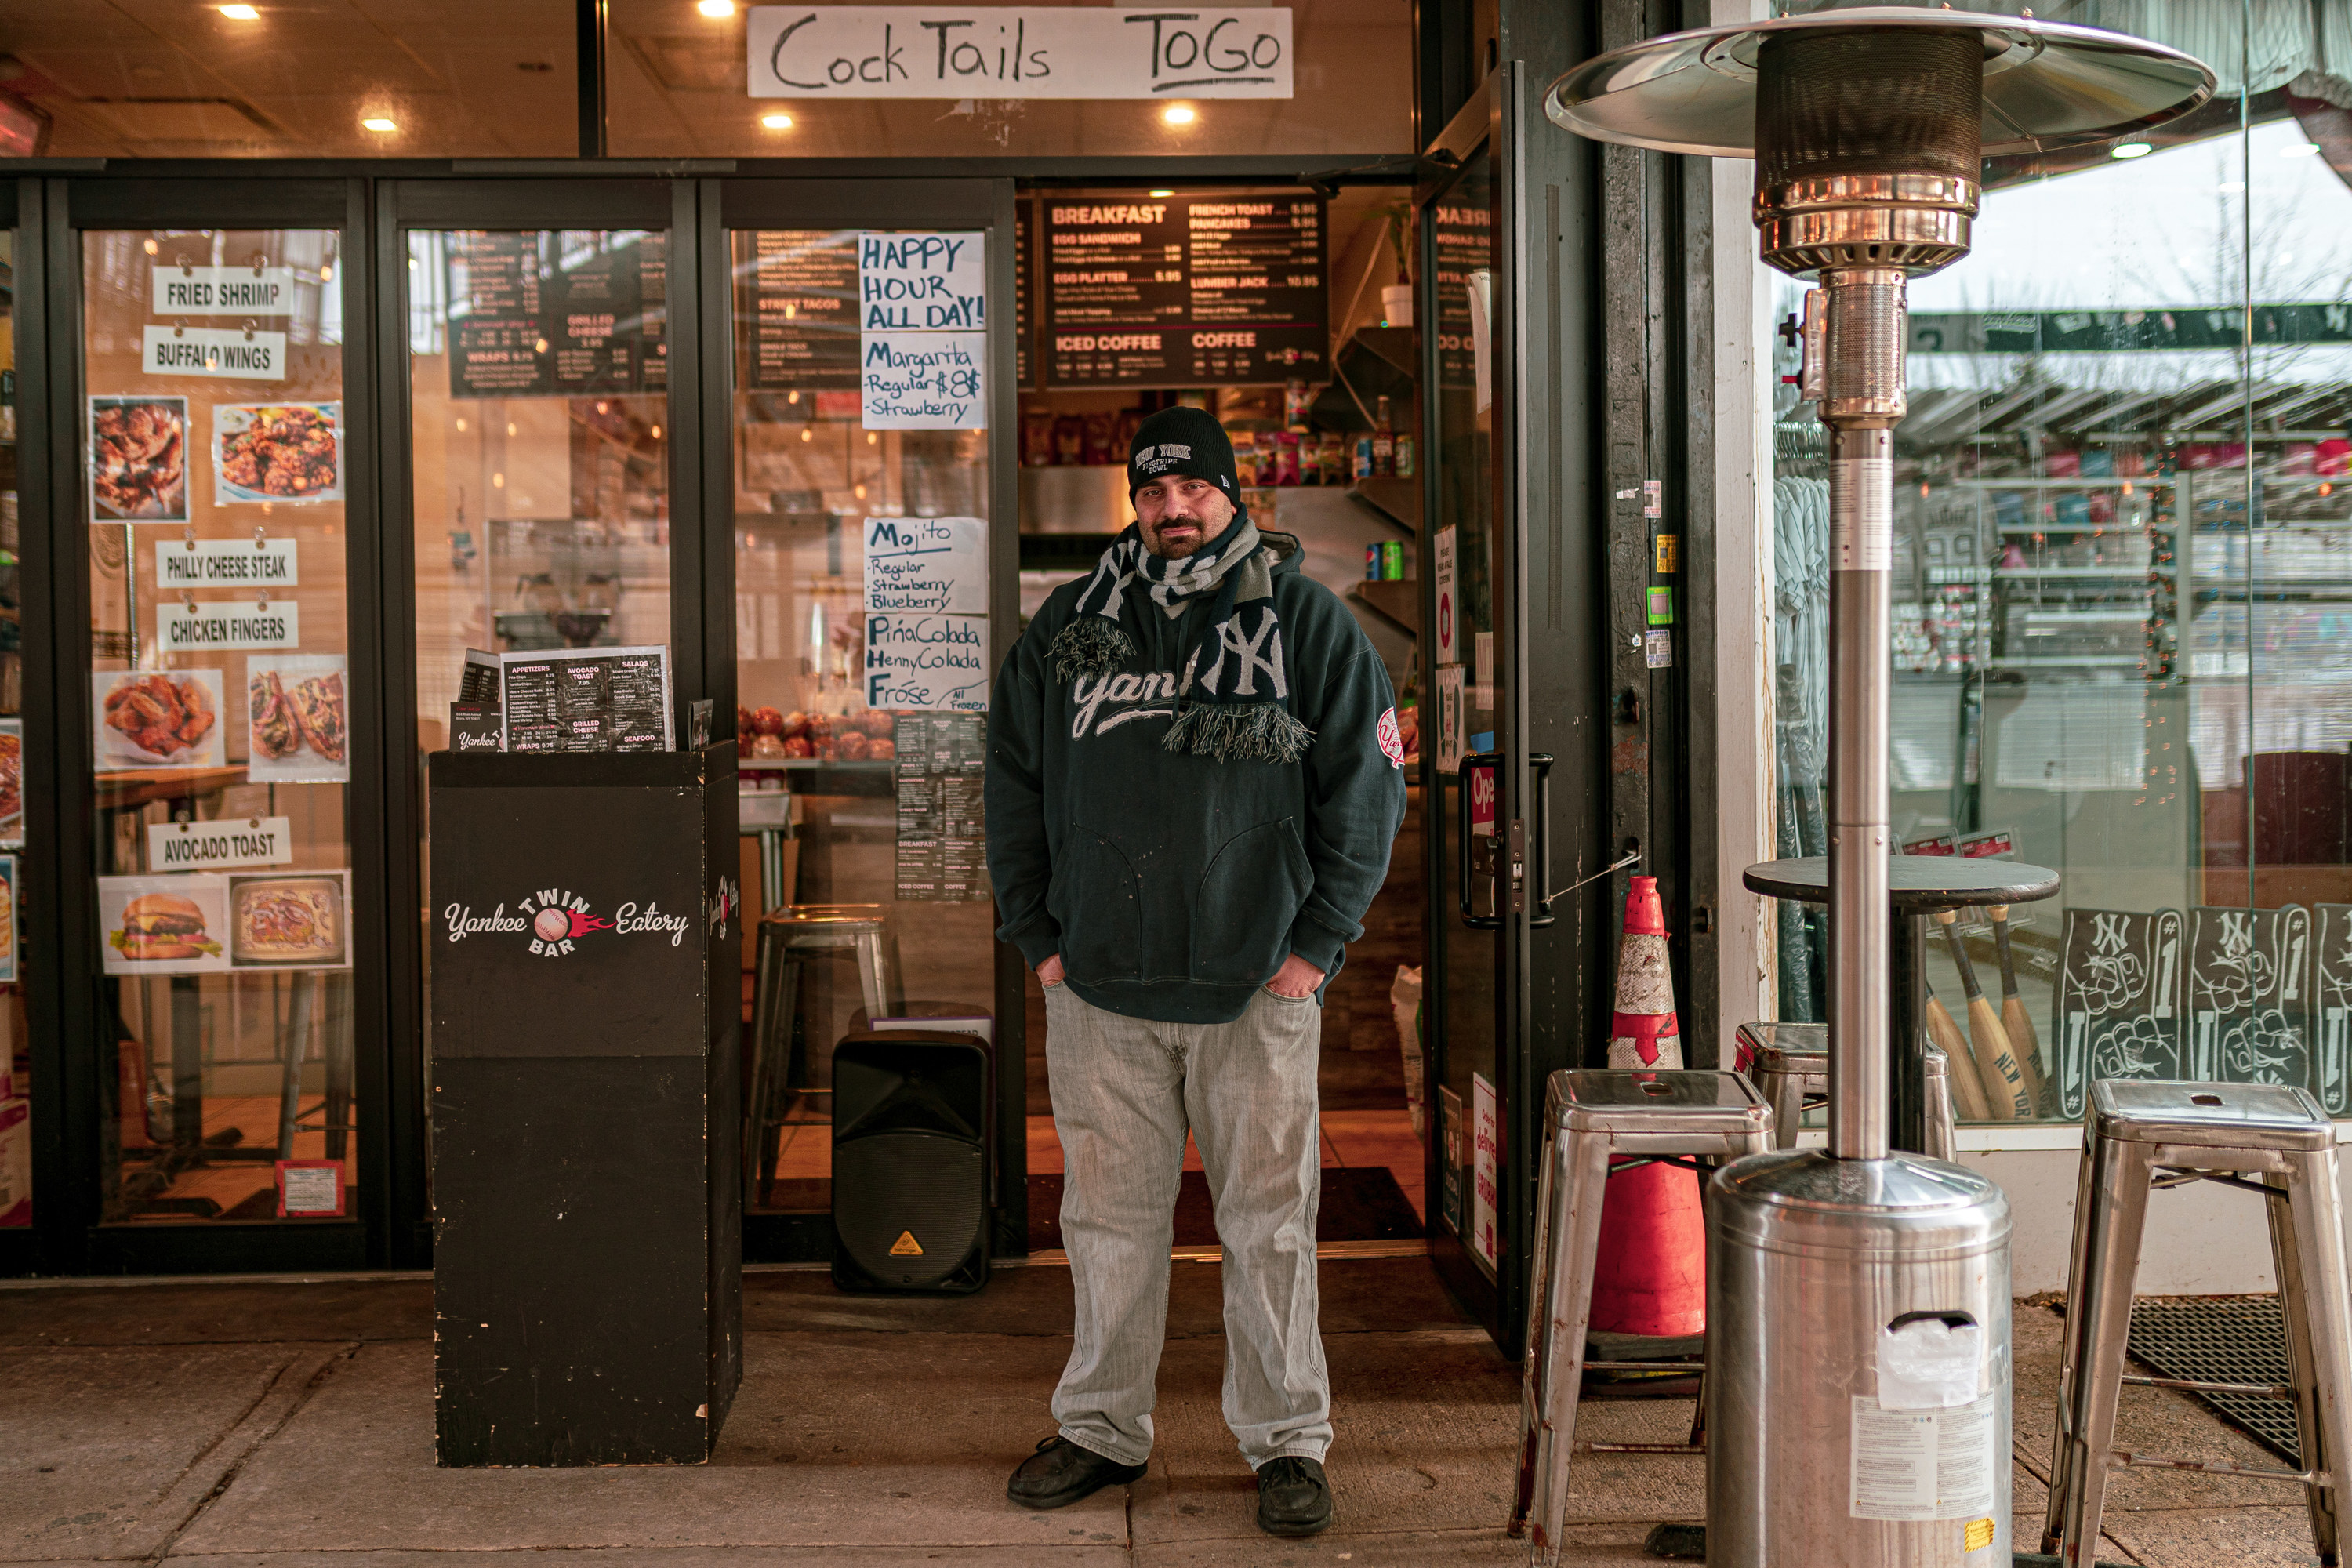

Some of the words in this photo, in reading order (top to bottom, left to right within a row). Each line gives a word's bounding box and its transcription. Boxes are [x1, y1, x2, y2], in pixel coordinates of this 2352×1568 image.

[1052, 205, 1167, 224] BREAKFAST
[862, 237, 964, 272] HAPPY
[168, 283, 212, 305] FRIED
[220, 283, 279, 306] SHRIMP
[864, 276, 953, 302] HOUR
[803, 299, 841, 310] TACOS
[867, 304, 920, 328] ALL
[927, 296, 984, 328] DAY!
[1056, 336, 1096, 351] ICED
[1098, 335, 1162, 350] COFFEE
[1192, 332, 1256, 348] COFFEE
[157, 343, 220, 367] BUFFALO
[224, 346, 270, 370] WINGS
[467, 351, 509, 362] WRAPS
[866, 342, 972, 378] Margarita
[1135, 446, 1155, 469] NEW
[1159, 444, 1191, 459] YORK
[1142, 458, 1178, 470] PINSTRIPE
[1149, 464, 1168, 474] BOWL
[870, 521, 951, 556] Mojito
[168, 557, 204, 579] PHILLY
[207, 557, 248, 578] CHEESE
[251, 556, 286, 578] STEAK
[171, 619, 227, 642] CHICKEN
[231, 618, 284, 641] FINGERS
[1200, 605, 1287, 699] NY
[950, 700, 987, 710] Frozen
[459, 731, 495, 750] Yankee
[165, 836, 227, 862] AVOCADO
[232, 834, 274, 857] TOAST
[518, 887, 590, 916] TWIN
[444, 902, 527, 942] Yankee
[616, 902, 689, 947] Eatery
[2092, 913, 2132, 956] NY
[528, 938, 576, 957] BAR
[1994, 1051, 2021, 1083] NEW
